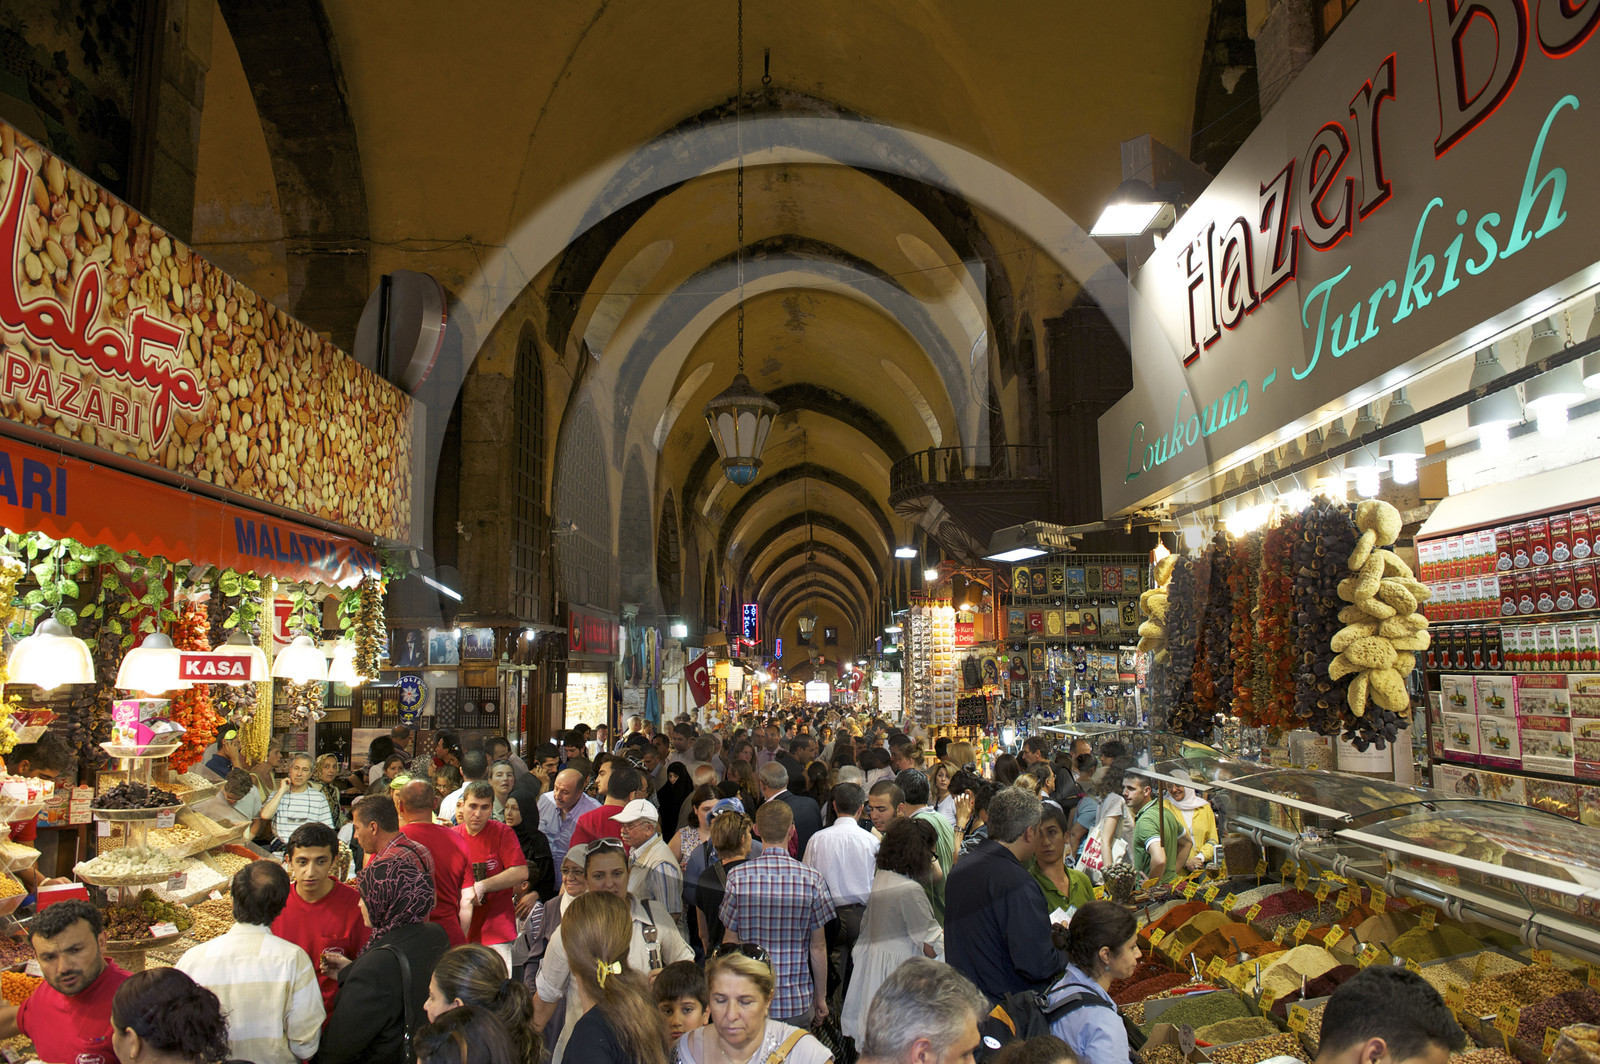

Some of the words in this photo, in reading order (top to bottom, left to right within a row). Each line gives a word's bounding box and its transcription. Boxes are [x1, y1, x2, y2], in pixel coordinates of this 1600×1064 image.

[1176, 52, 1397, 368] Hazer
[1124, 389, 1249, 485] Loukoum
[1291, 94, 1580, 381] Turkish
[2, 351, 143, 440] PAZARI
[234, 517, 341, 573] MALATYA
[185, 660, 246, 676] KASA
